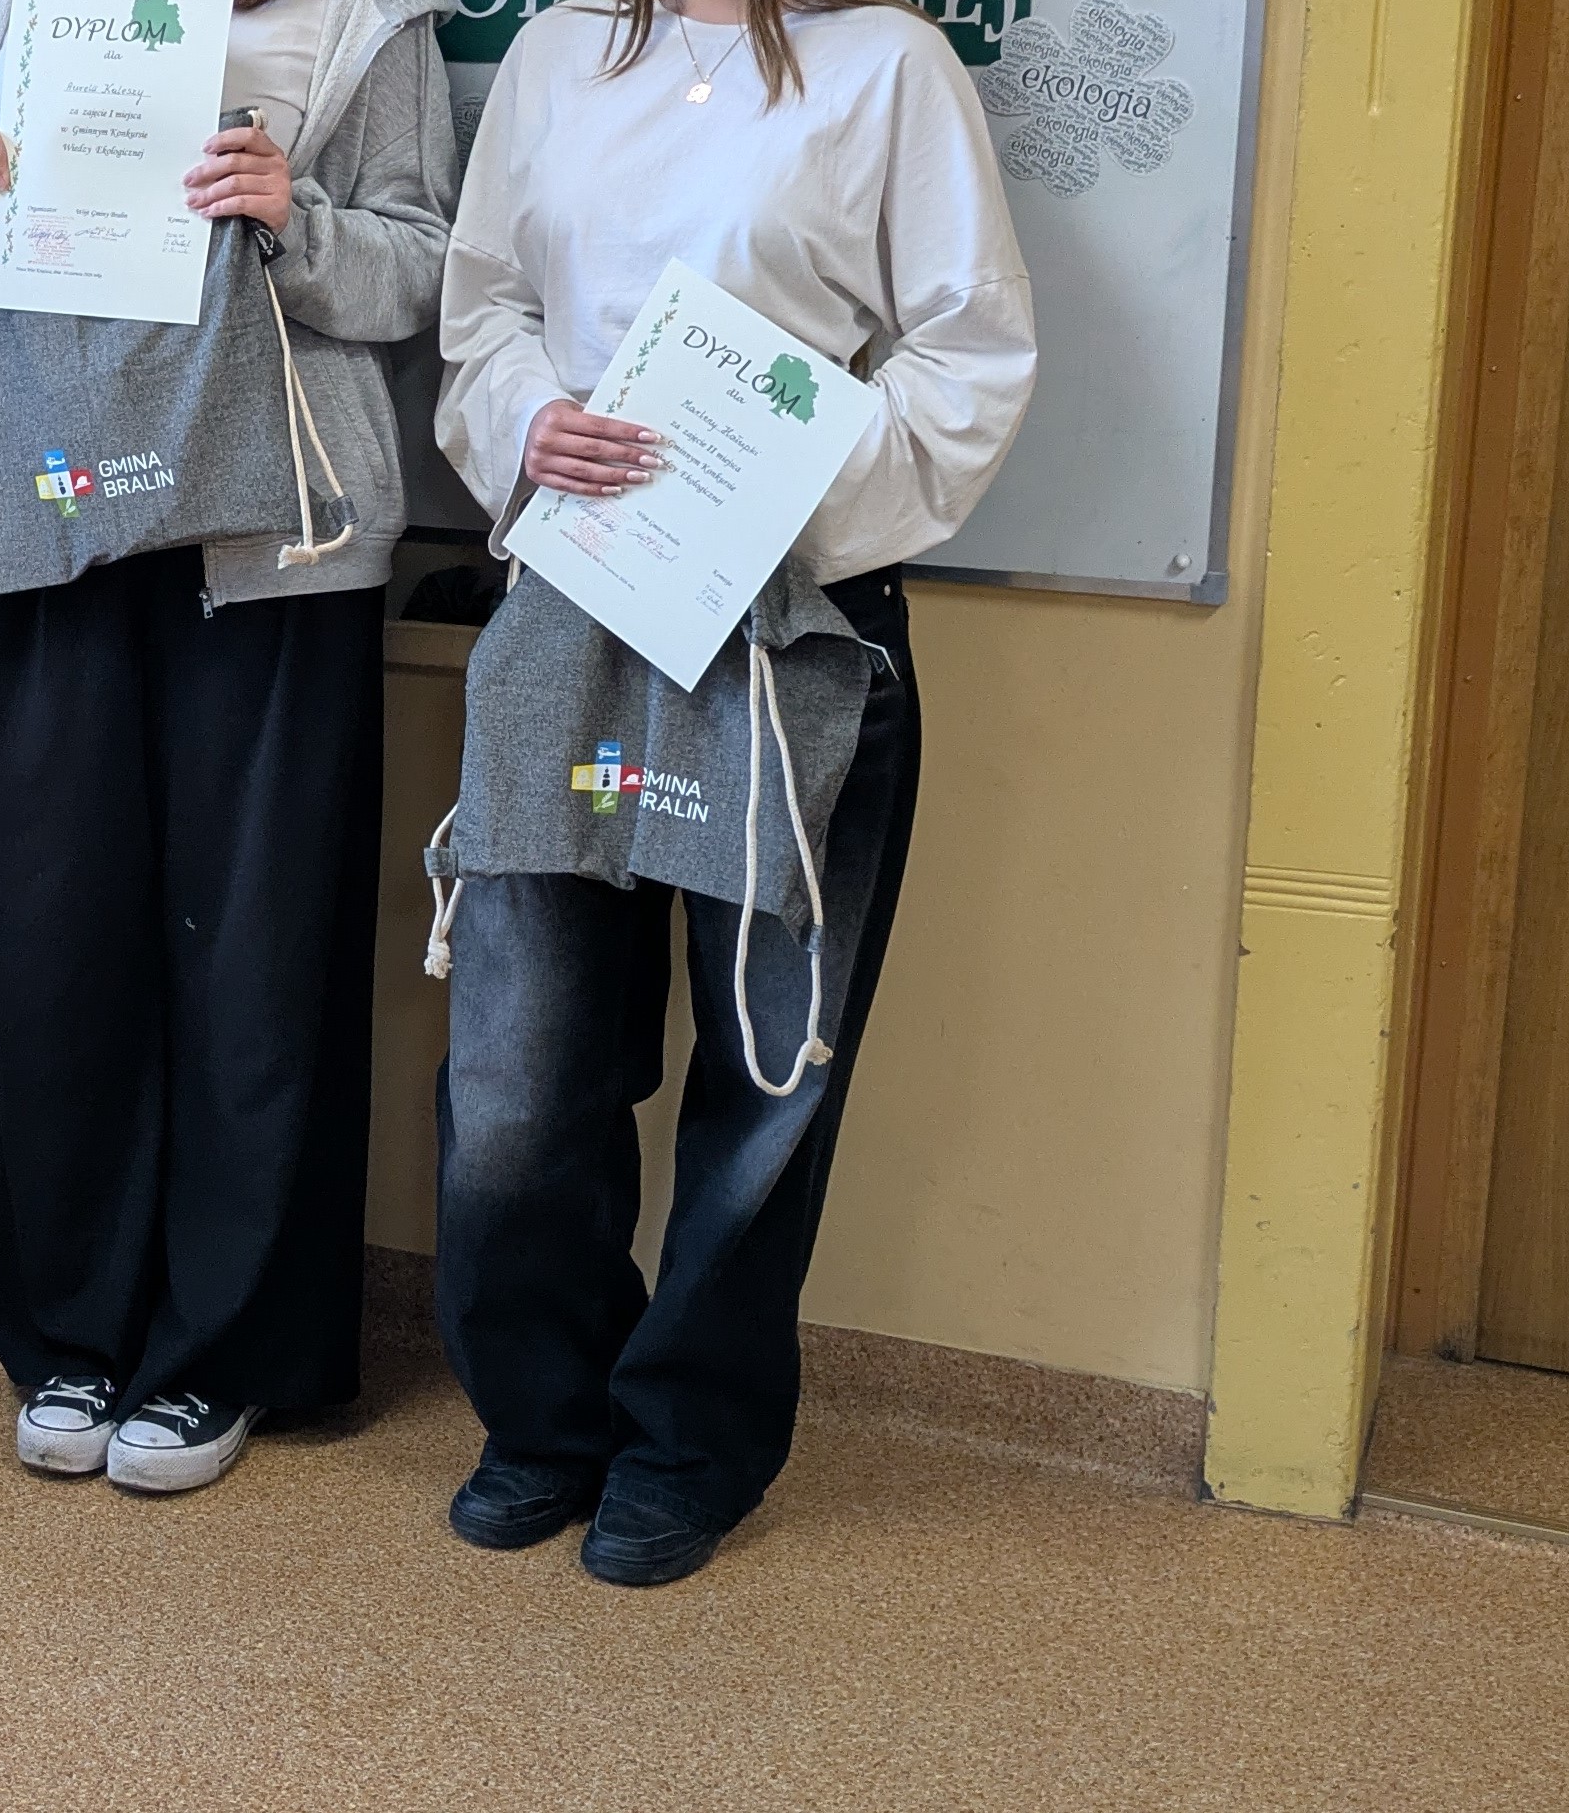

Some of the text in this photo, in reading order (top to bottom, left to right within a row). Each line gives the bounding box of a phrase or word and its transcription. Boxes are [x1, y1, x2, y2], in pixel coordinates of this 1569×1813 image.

[51, 16, 167, 45] DYPLOM
[1088, 7, 1146, 52] ekologia
[103, 50, 124, 60] dla
[1079, 54, 1132, 79] ekologia
[1021, 65, 1152, 123] ekologia
[109, 109, 114, 118] I
[115, 111, 142, 121] miejsca
[1036, 115, 1100, 144] ekologia
[72, 125, 108, 138] Gminnym
[109, 128, 148, 140] Konkursie
[62, 143, 145, 160] Wiedzy Ekologicznej
[1011, 139, 1075, 169] ekologia
[683, 325, 802, 415] DYPLOM
[726, 388, 747, 404] dla
[670, 420, 681, 430] za
[706, 444, 718, 454] II
[98, 450, 163, 478] GMINA
[666, 439, 737, 492] Gminnym Konkursie
[102, 468, 175, 498] BRALIN
[679, 470, 726, 507] Ekologicznej
[639, 789, 709, 823] RALIN
